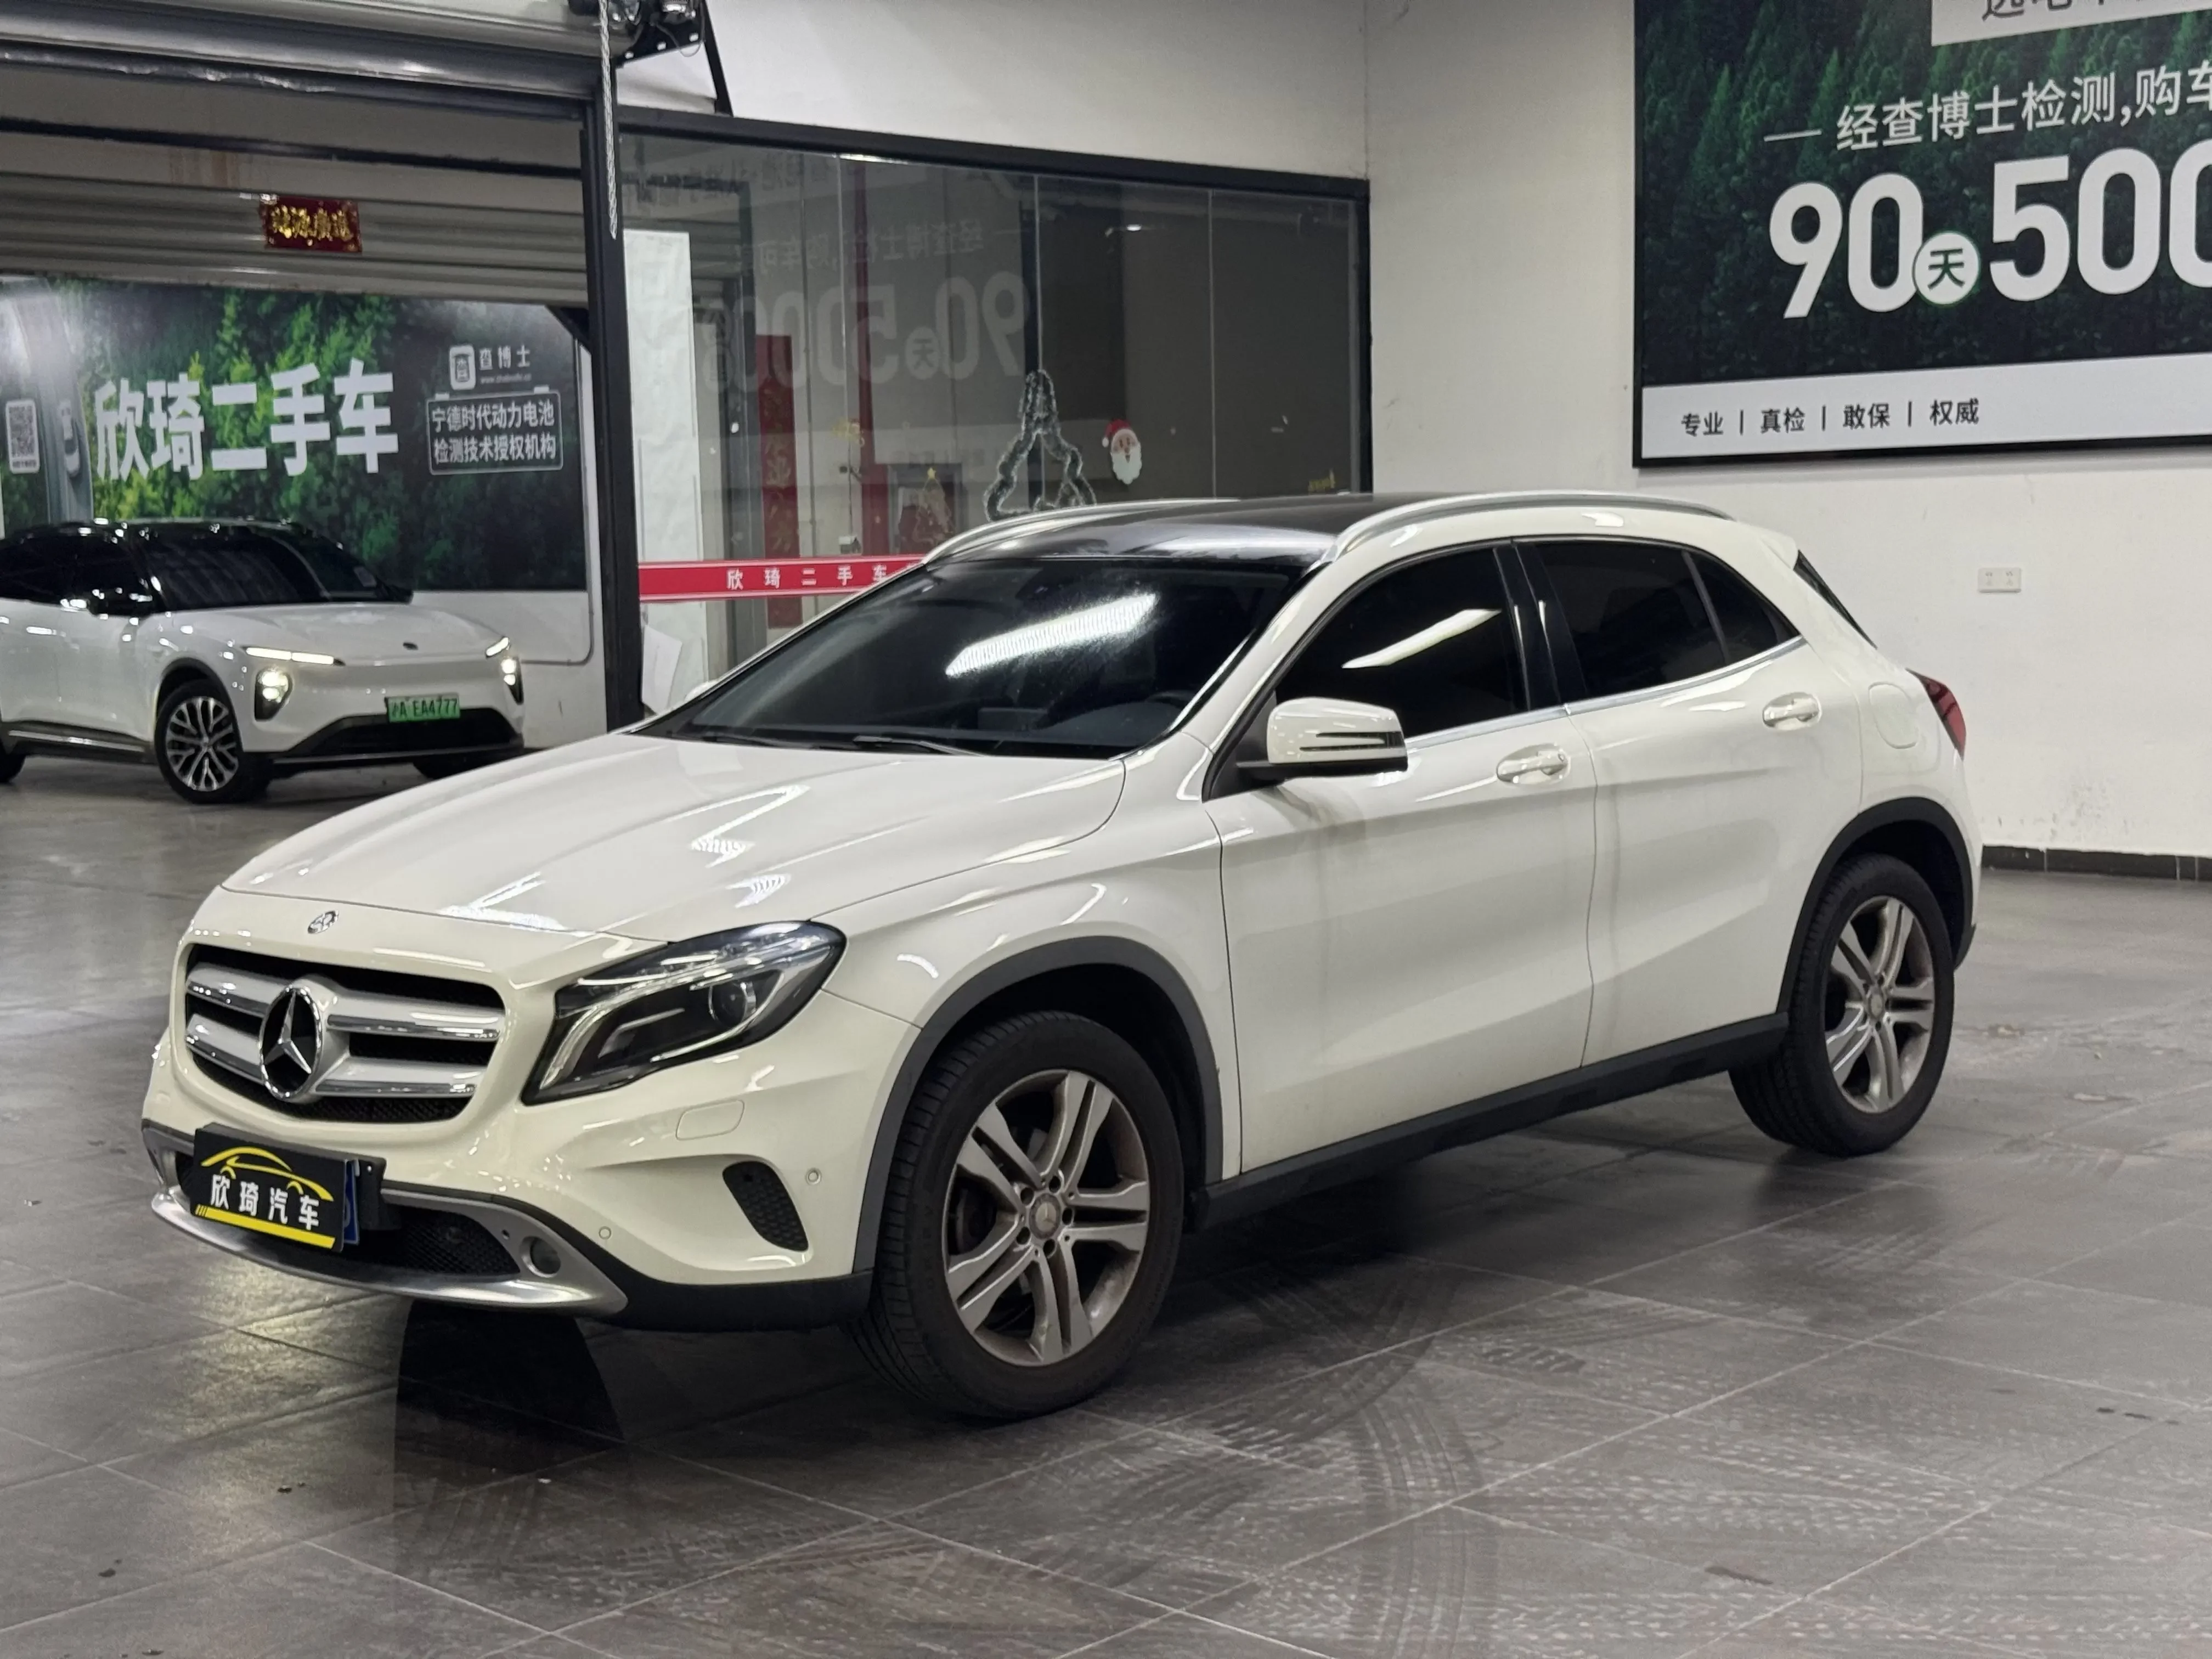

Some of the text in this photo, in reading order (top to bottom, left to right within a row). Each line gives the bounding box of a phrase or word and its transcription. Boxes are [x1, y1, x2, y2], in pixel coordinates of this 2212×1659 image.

[94, 357, 398, 481] 欣琦二手车
[432, 399, 555, 432] 宁德时代动力电池
[1681, 398, 1979, 436] 专业 真检 敢保 权威
[434, 431, 556, 465] 检测技术授权机构
[727, 564, 888, 590] 欣琦二手车
[210, 1174, 319, 1231] 欣琦汽车
